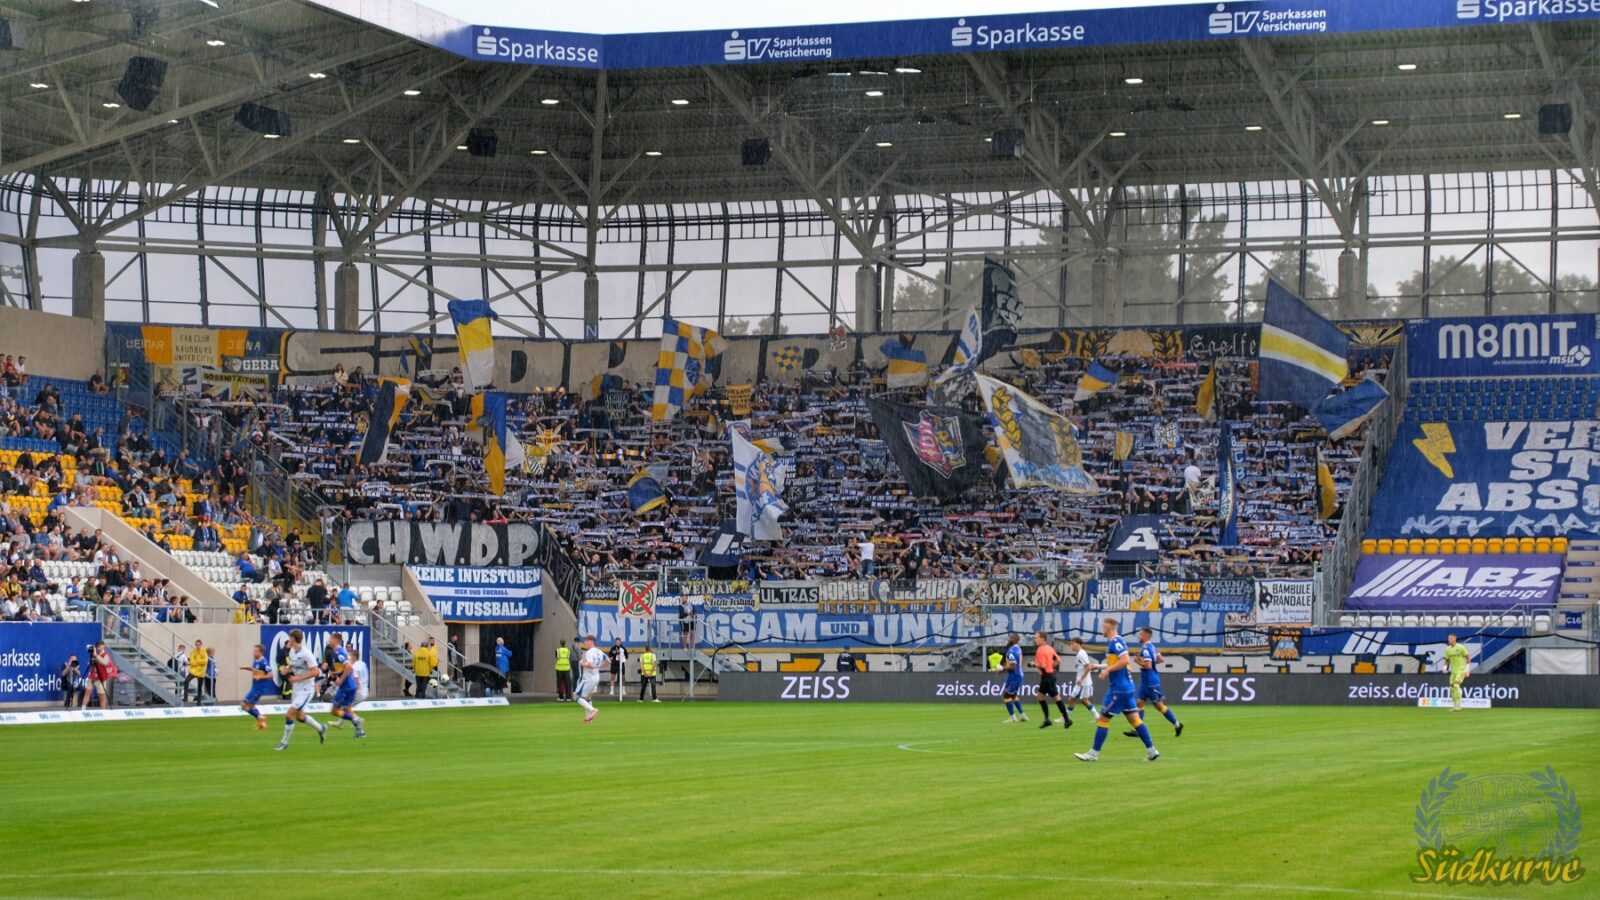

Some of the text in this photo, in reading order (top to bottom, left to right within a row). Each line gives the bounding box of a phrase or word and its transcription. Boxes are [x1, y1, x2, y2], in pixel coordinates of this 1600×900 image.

[1263, 8, 1326, 21] Sparkassen
[1257, 18, 1326, 33] Versicherung
[773, 35, 832, 48] Sparkassen
[977, 22, 1085, 49] Sparkasse
[499, 36, 598, 63] Sparkasse
[768, 45, 832, 59] Versicherung
[1438, 321, 1577, 360] M8MIT
[242, 359, 280, 371] GERA
[1549, 354, 1575, 365] msu
[411, 565, 541, 584] KEINE INVESTOREN
[1417, 567, 1562, 588] ABZ
[469, 588, 481, 596] UND
[762, 587, 819, 603] ULTRAS
[990, 581, 1086, 606] HARAKIRI
[1272, 583, 1312, 595] BAMBULE
[1402, 586, 1549, 600] Nutzfahrzeuge
[456, 600, 528, 617] FUSSBALL
[1273, 595, 1312, 607] RANDALE
[1566, 616, 1582, 625] C16
[831, 622, 860, 635] UND
[0, 648, 41, 668] arkasse
[780, 675, 851, 700] ZEISS
[1181, 677, 1257, 702] ZEISS
